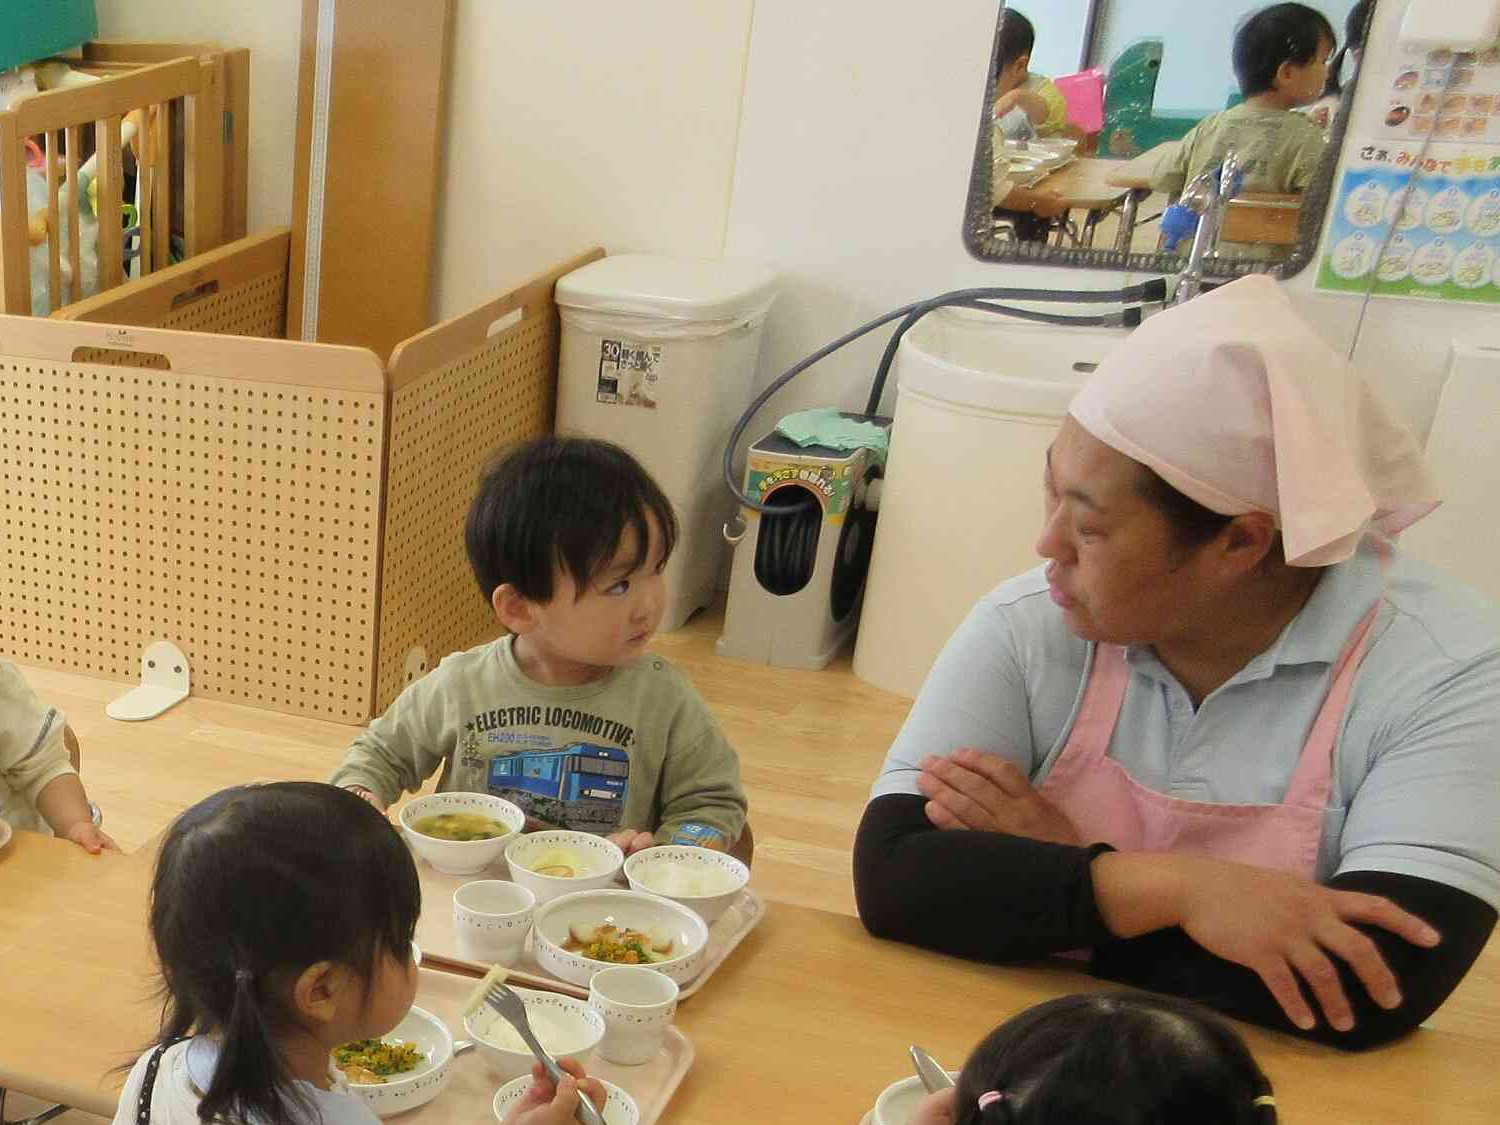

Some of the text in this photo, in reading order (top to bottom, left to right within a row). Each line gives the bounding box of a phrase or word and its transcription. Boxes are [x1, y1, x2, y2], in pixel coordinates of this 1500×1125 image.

[603, 343, 620, 358] 30
[475, 706, 633, 747] ELECTRIC LOCOMOTIVE
